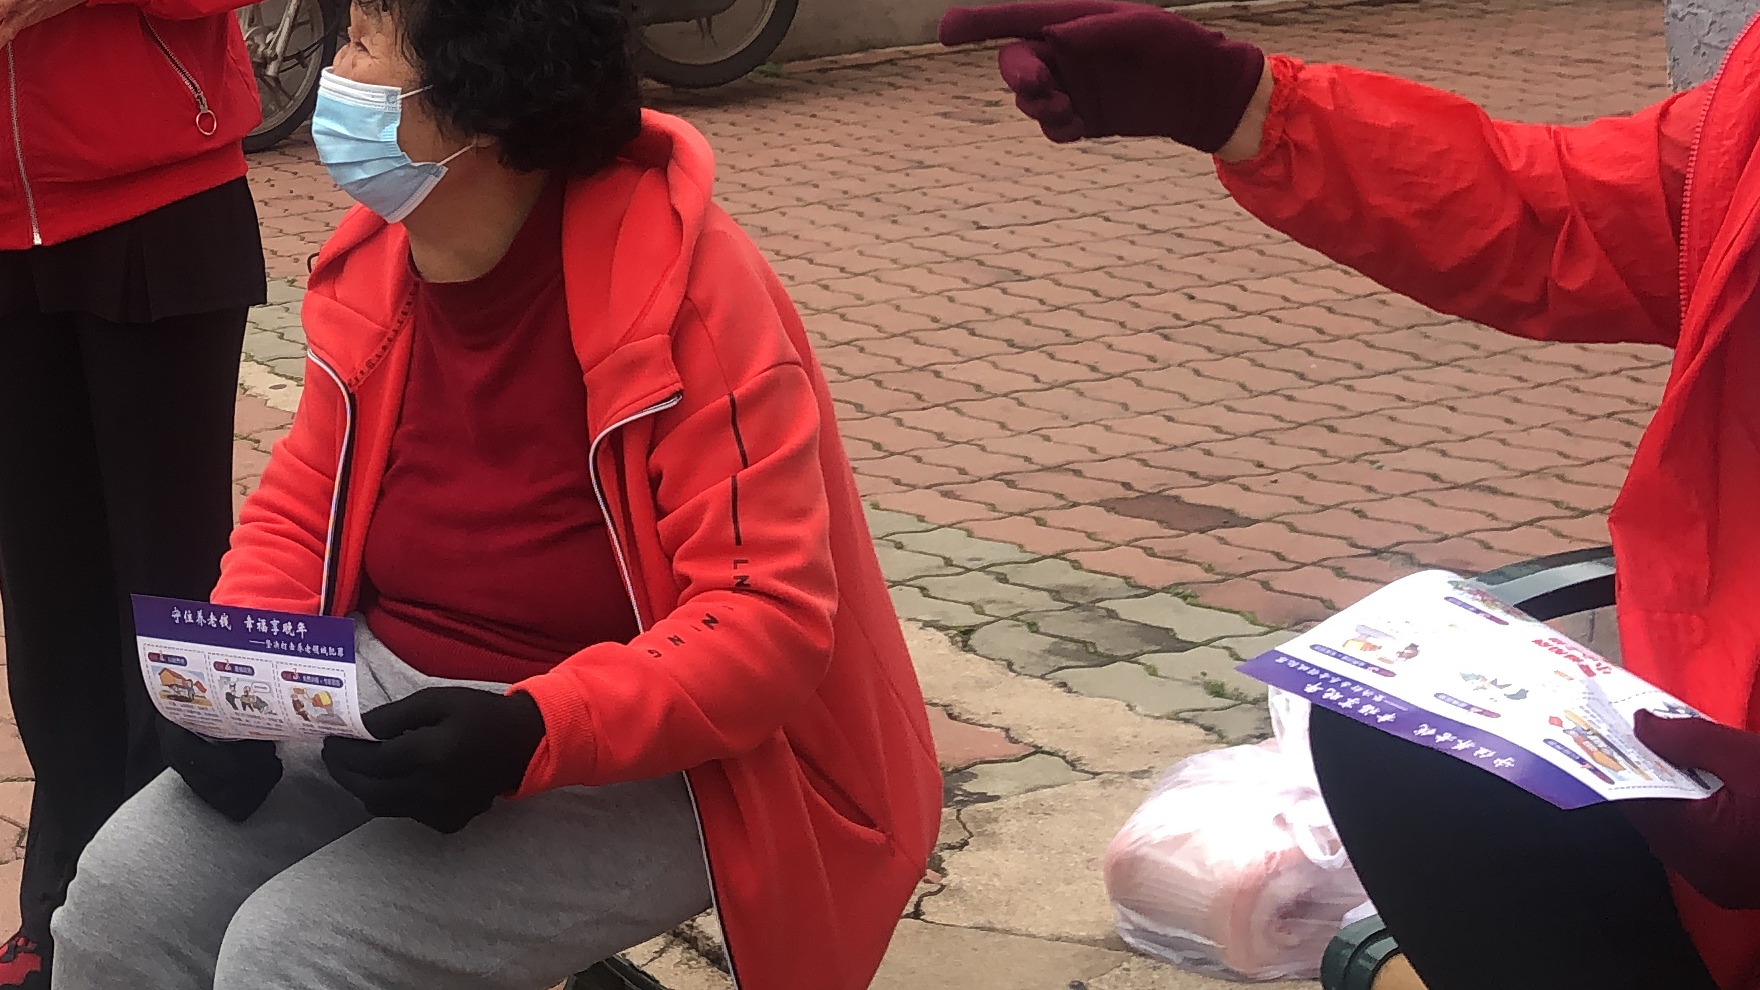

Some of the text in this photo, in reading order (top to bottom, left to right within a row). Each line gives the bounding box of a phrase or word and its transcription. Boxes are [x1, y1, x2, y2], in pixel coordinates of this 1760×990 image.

[171, 606, 308, 640] 守住养老钱 幸福享晚年
